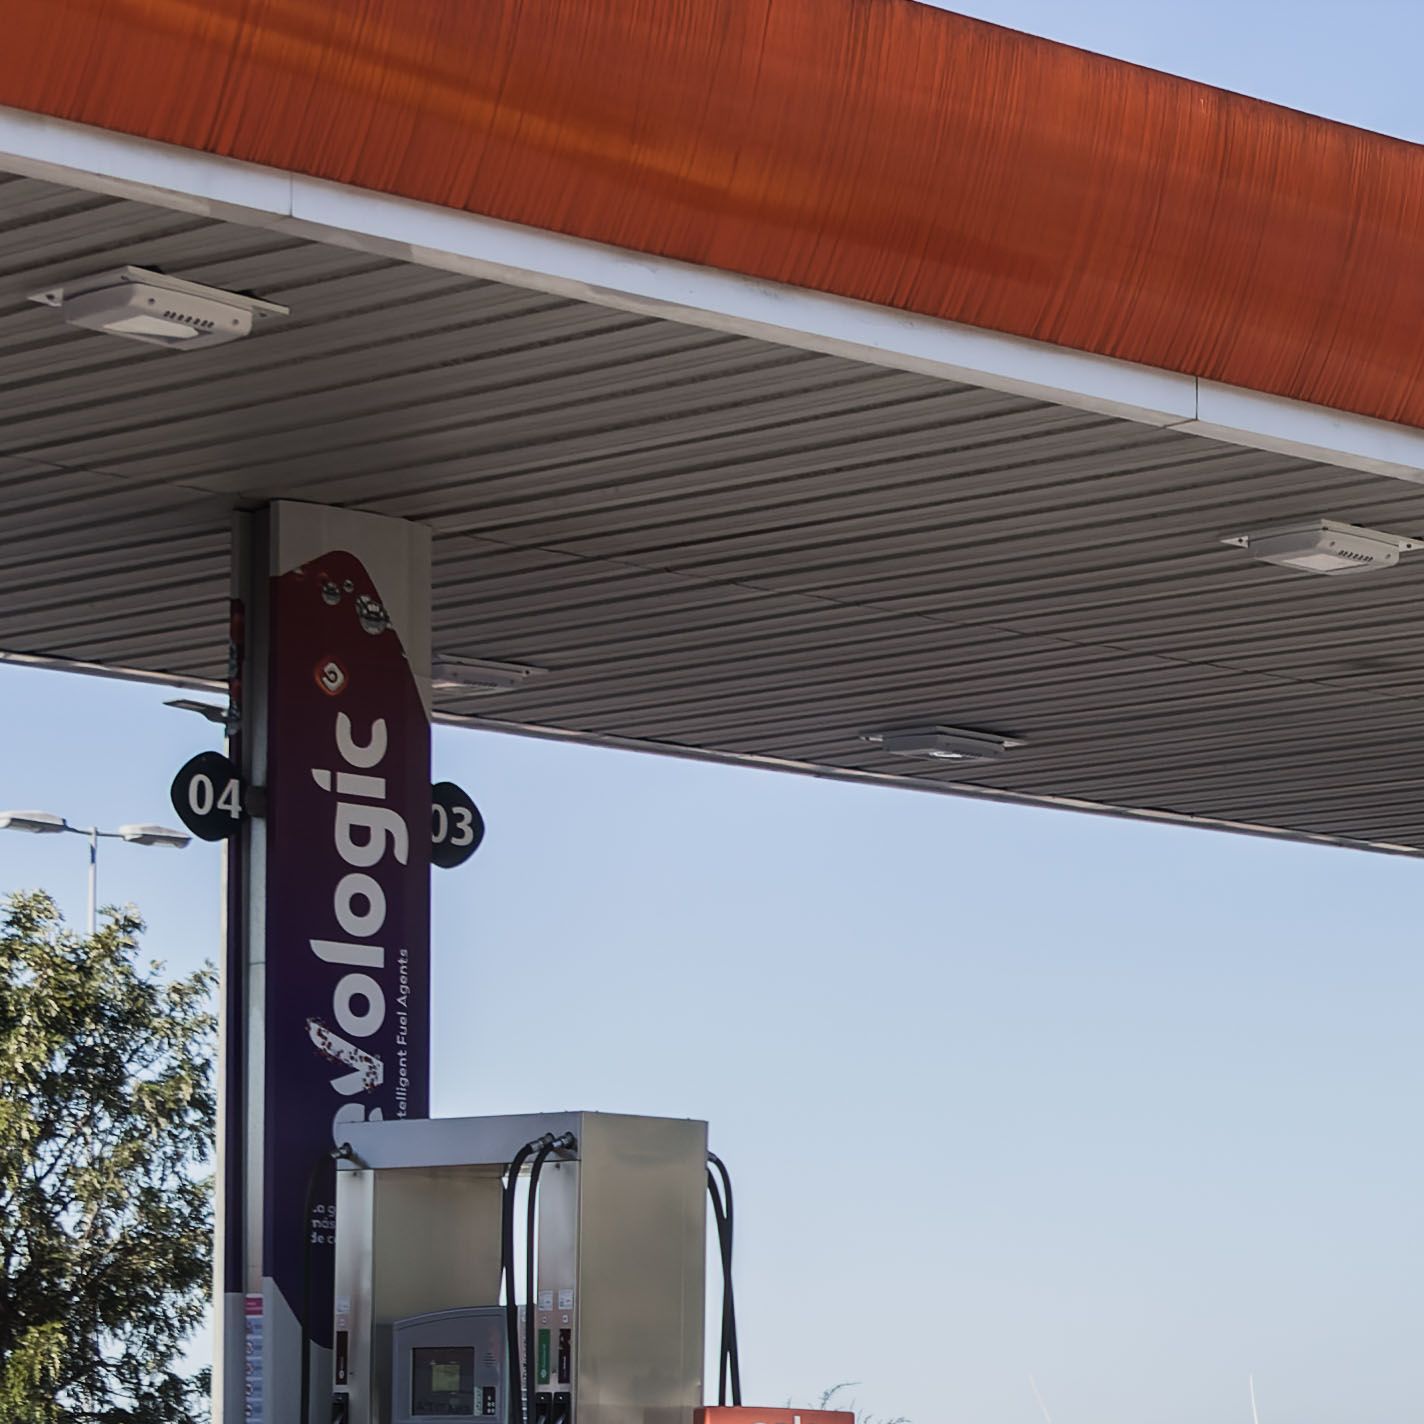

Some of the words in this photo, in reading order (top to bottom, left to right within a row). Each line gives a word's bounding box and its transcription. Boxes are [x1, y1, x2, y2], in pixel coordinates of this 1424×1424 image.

[188, 774, 242, 819] 04
[431, 804, 474, 847] 03
[396, 949, 411, 1006] Agents
[396, 1012, 408, 1045] Fuel
[396, 1050, 410, 1119] telligent
